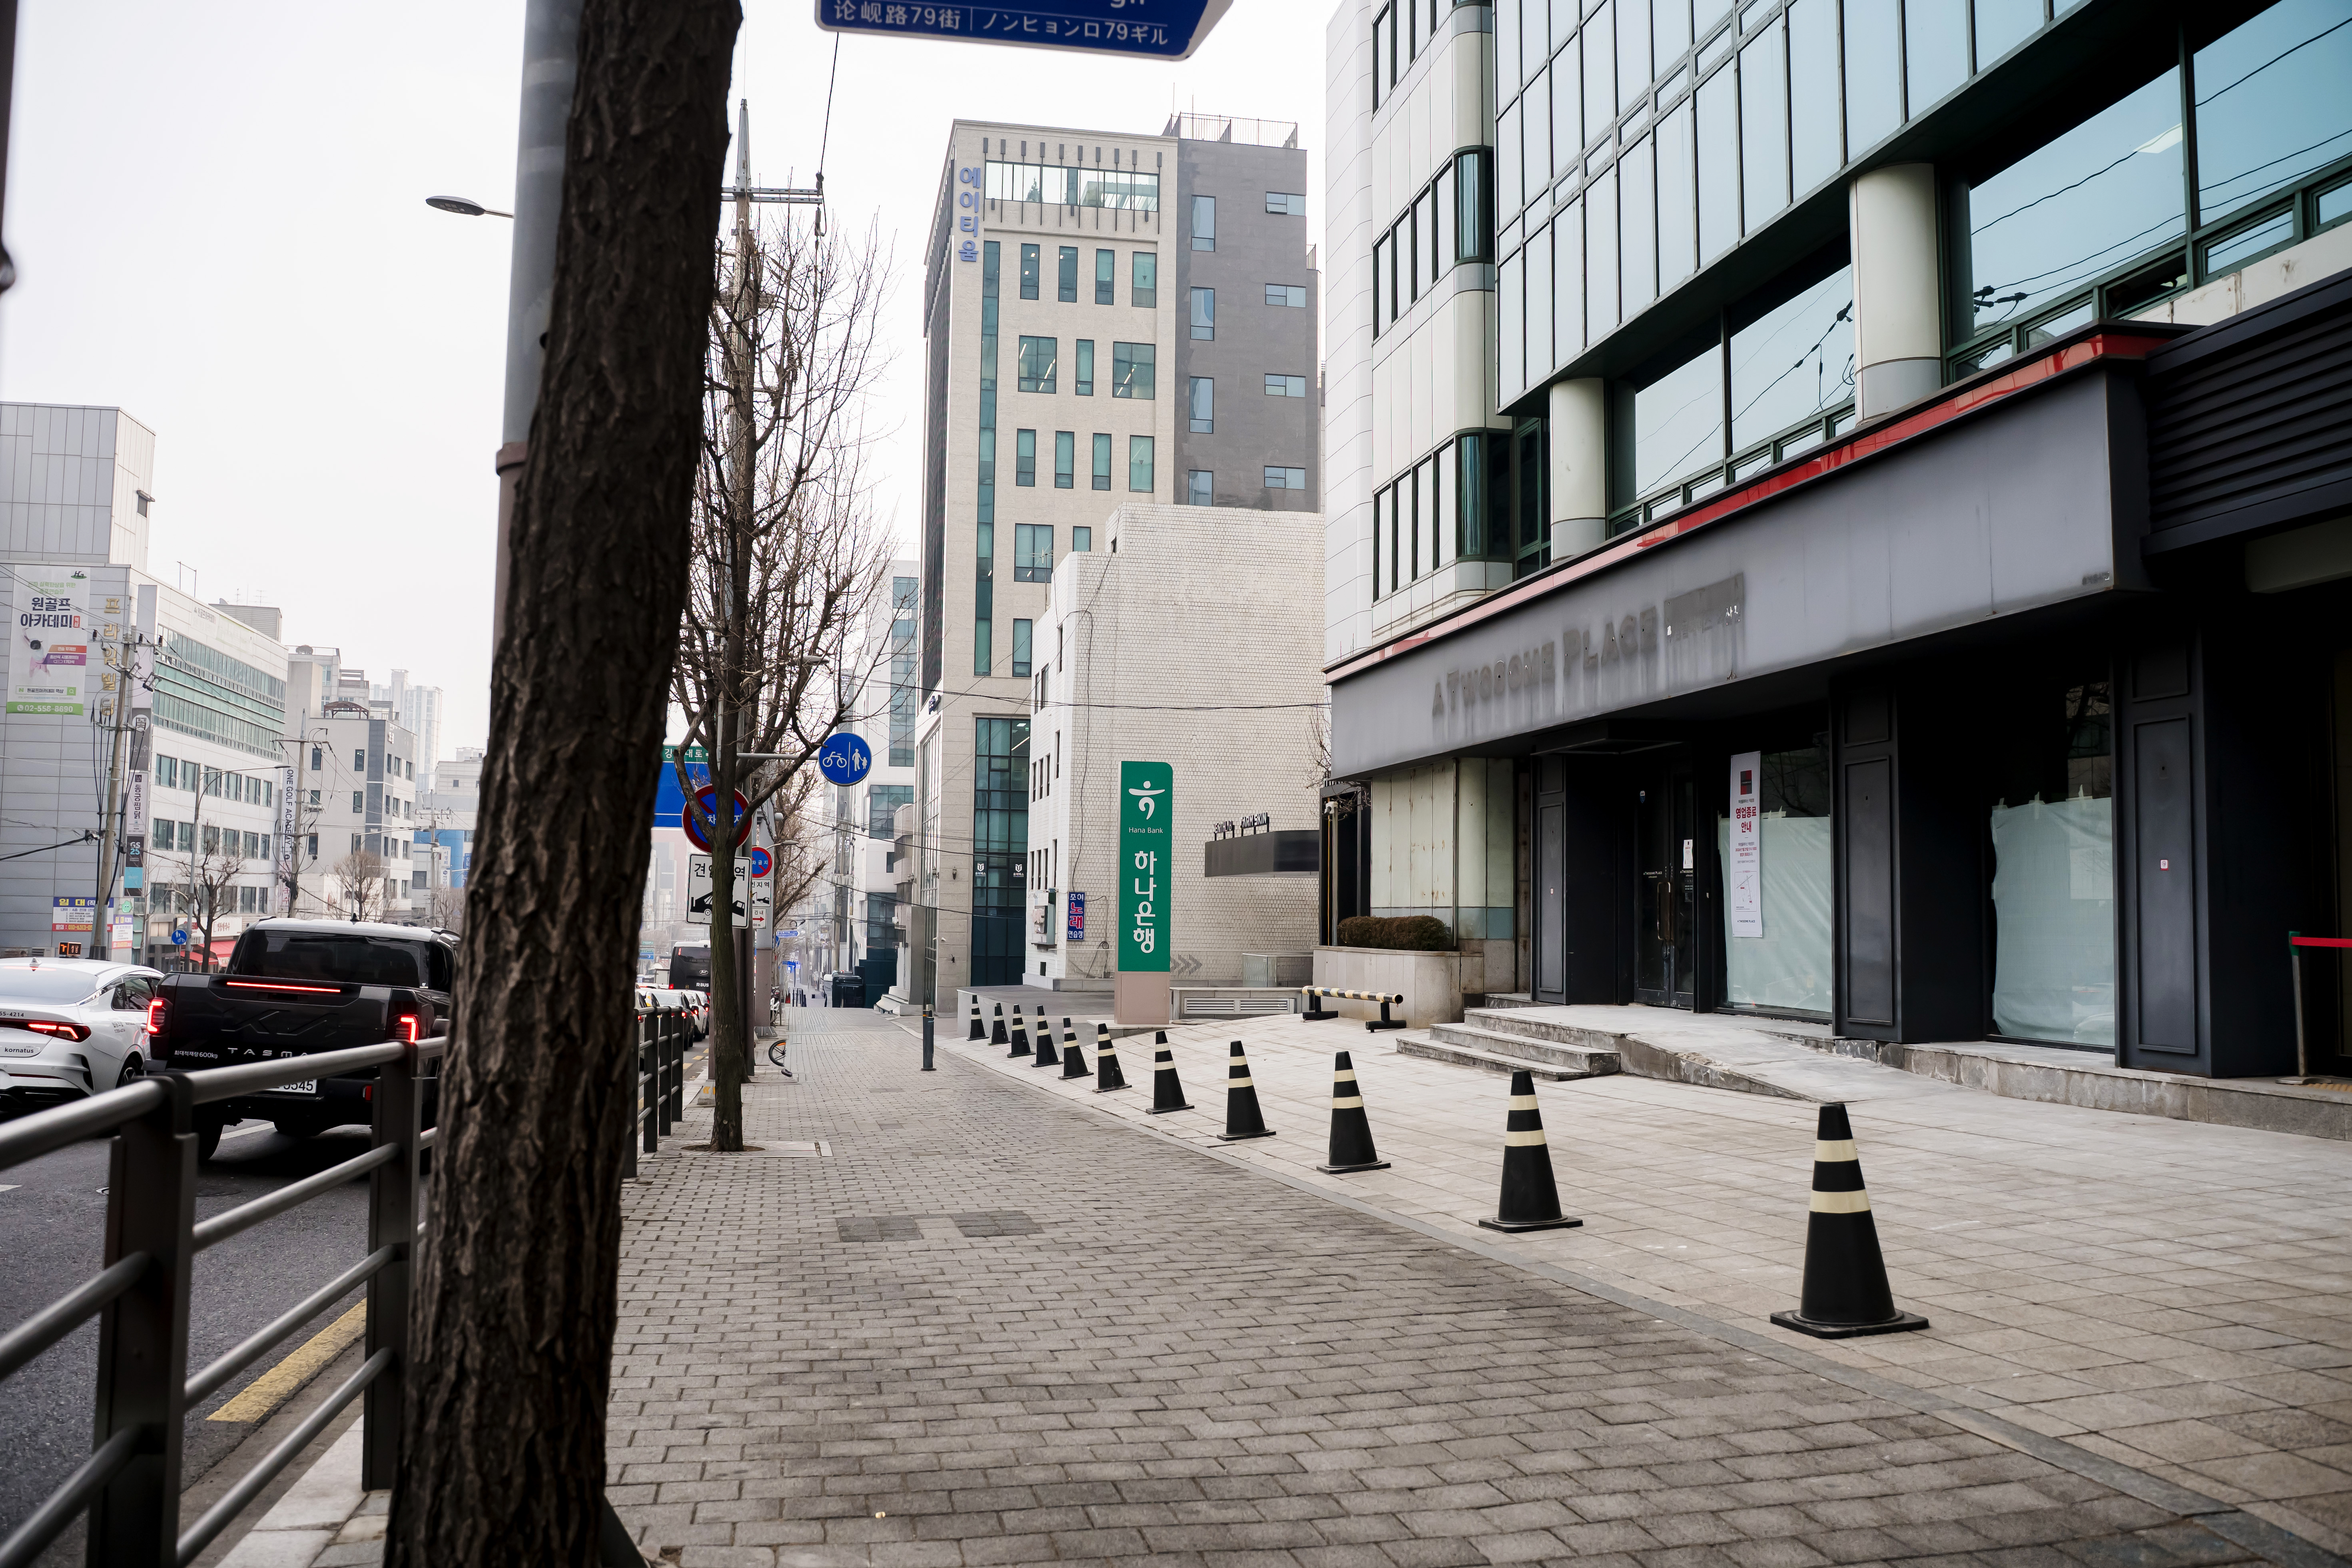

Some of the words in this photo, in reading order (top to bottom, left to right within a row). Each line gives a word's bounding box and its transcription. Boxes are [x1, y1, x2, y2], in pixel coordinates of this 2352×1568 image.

[958, 168, 981, 262] 에이티움
[32, 597, 70, 611] 원골프
[20, 614, 72, 628] 아카데미
[665, 749, 702, 759] 강대로
[1254, 812, 1267, 826] SKIN
[1736, 806, 1756, 819] 영업종료
[1741, 821, 1752, 833] 안내
[694, 863, 745, 881] 견역
[1133, 850, 1157, 954] 하나은행
[1069, 902, 1083, 929] 노래
[1068, 930, 1083, 939] 연습장
[227, 1047, 308, 1057] TASMA
